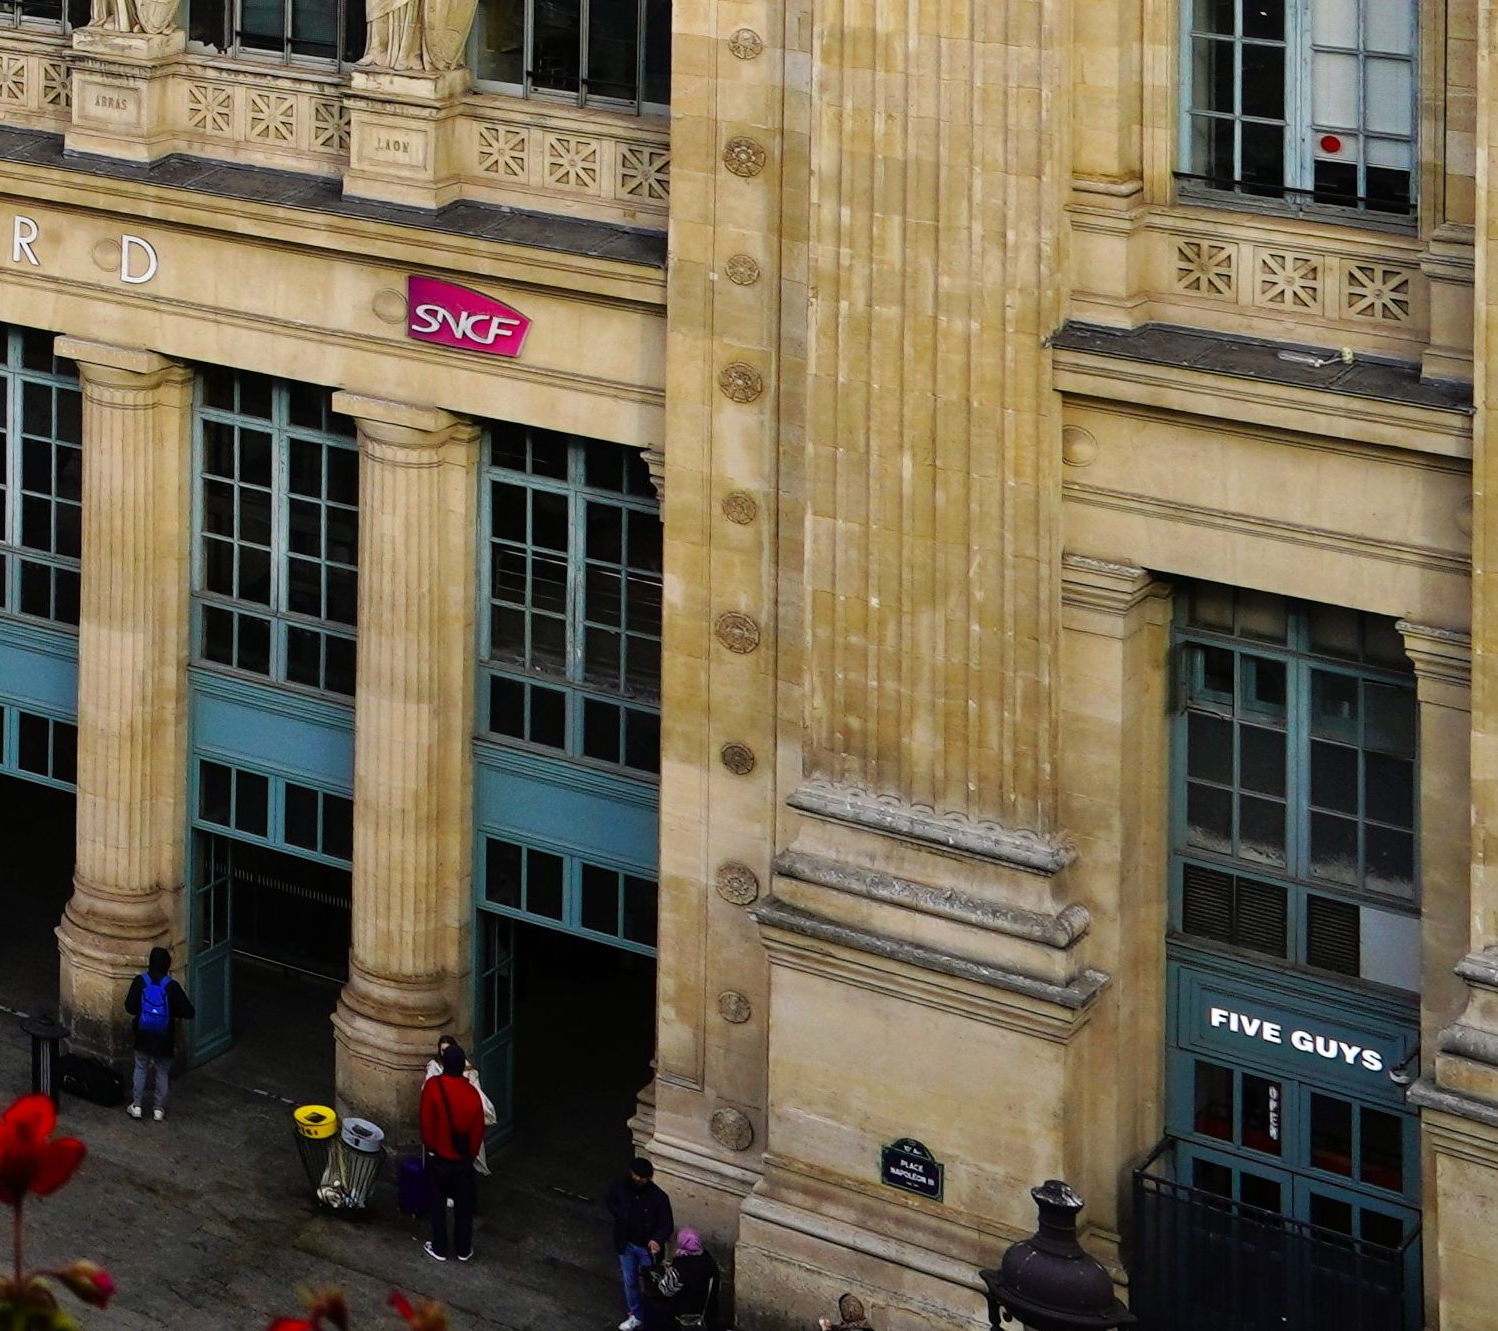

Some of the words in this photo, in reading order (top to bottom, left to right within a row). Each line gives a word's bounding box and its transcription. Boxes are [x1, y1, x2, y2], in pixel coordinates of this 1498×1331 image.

[374, 136, 410, 154] LAON
[412, 304, 521, 345] SNCF
[1210, 1007, 1282, 1044] FIVE
[1290, 1029, 1383, 1072] GUYS
[1268, 1086, 1279, 1141] OPEN
[900, 1159, 924, 1173] PLACE
[927, 1178, 935, 1186] III
